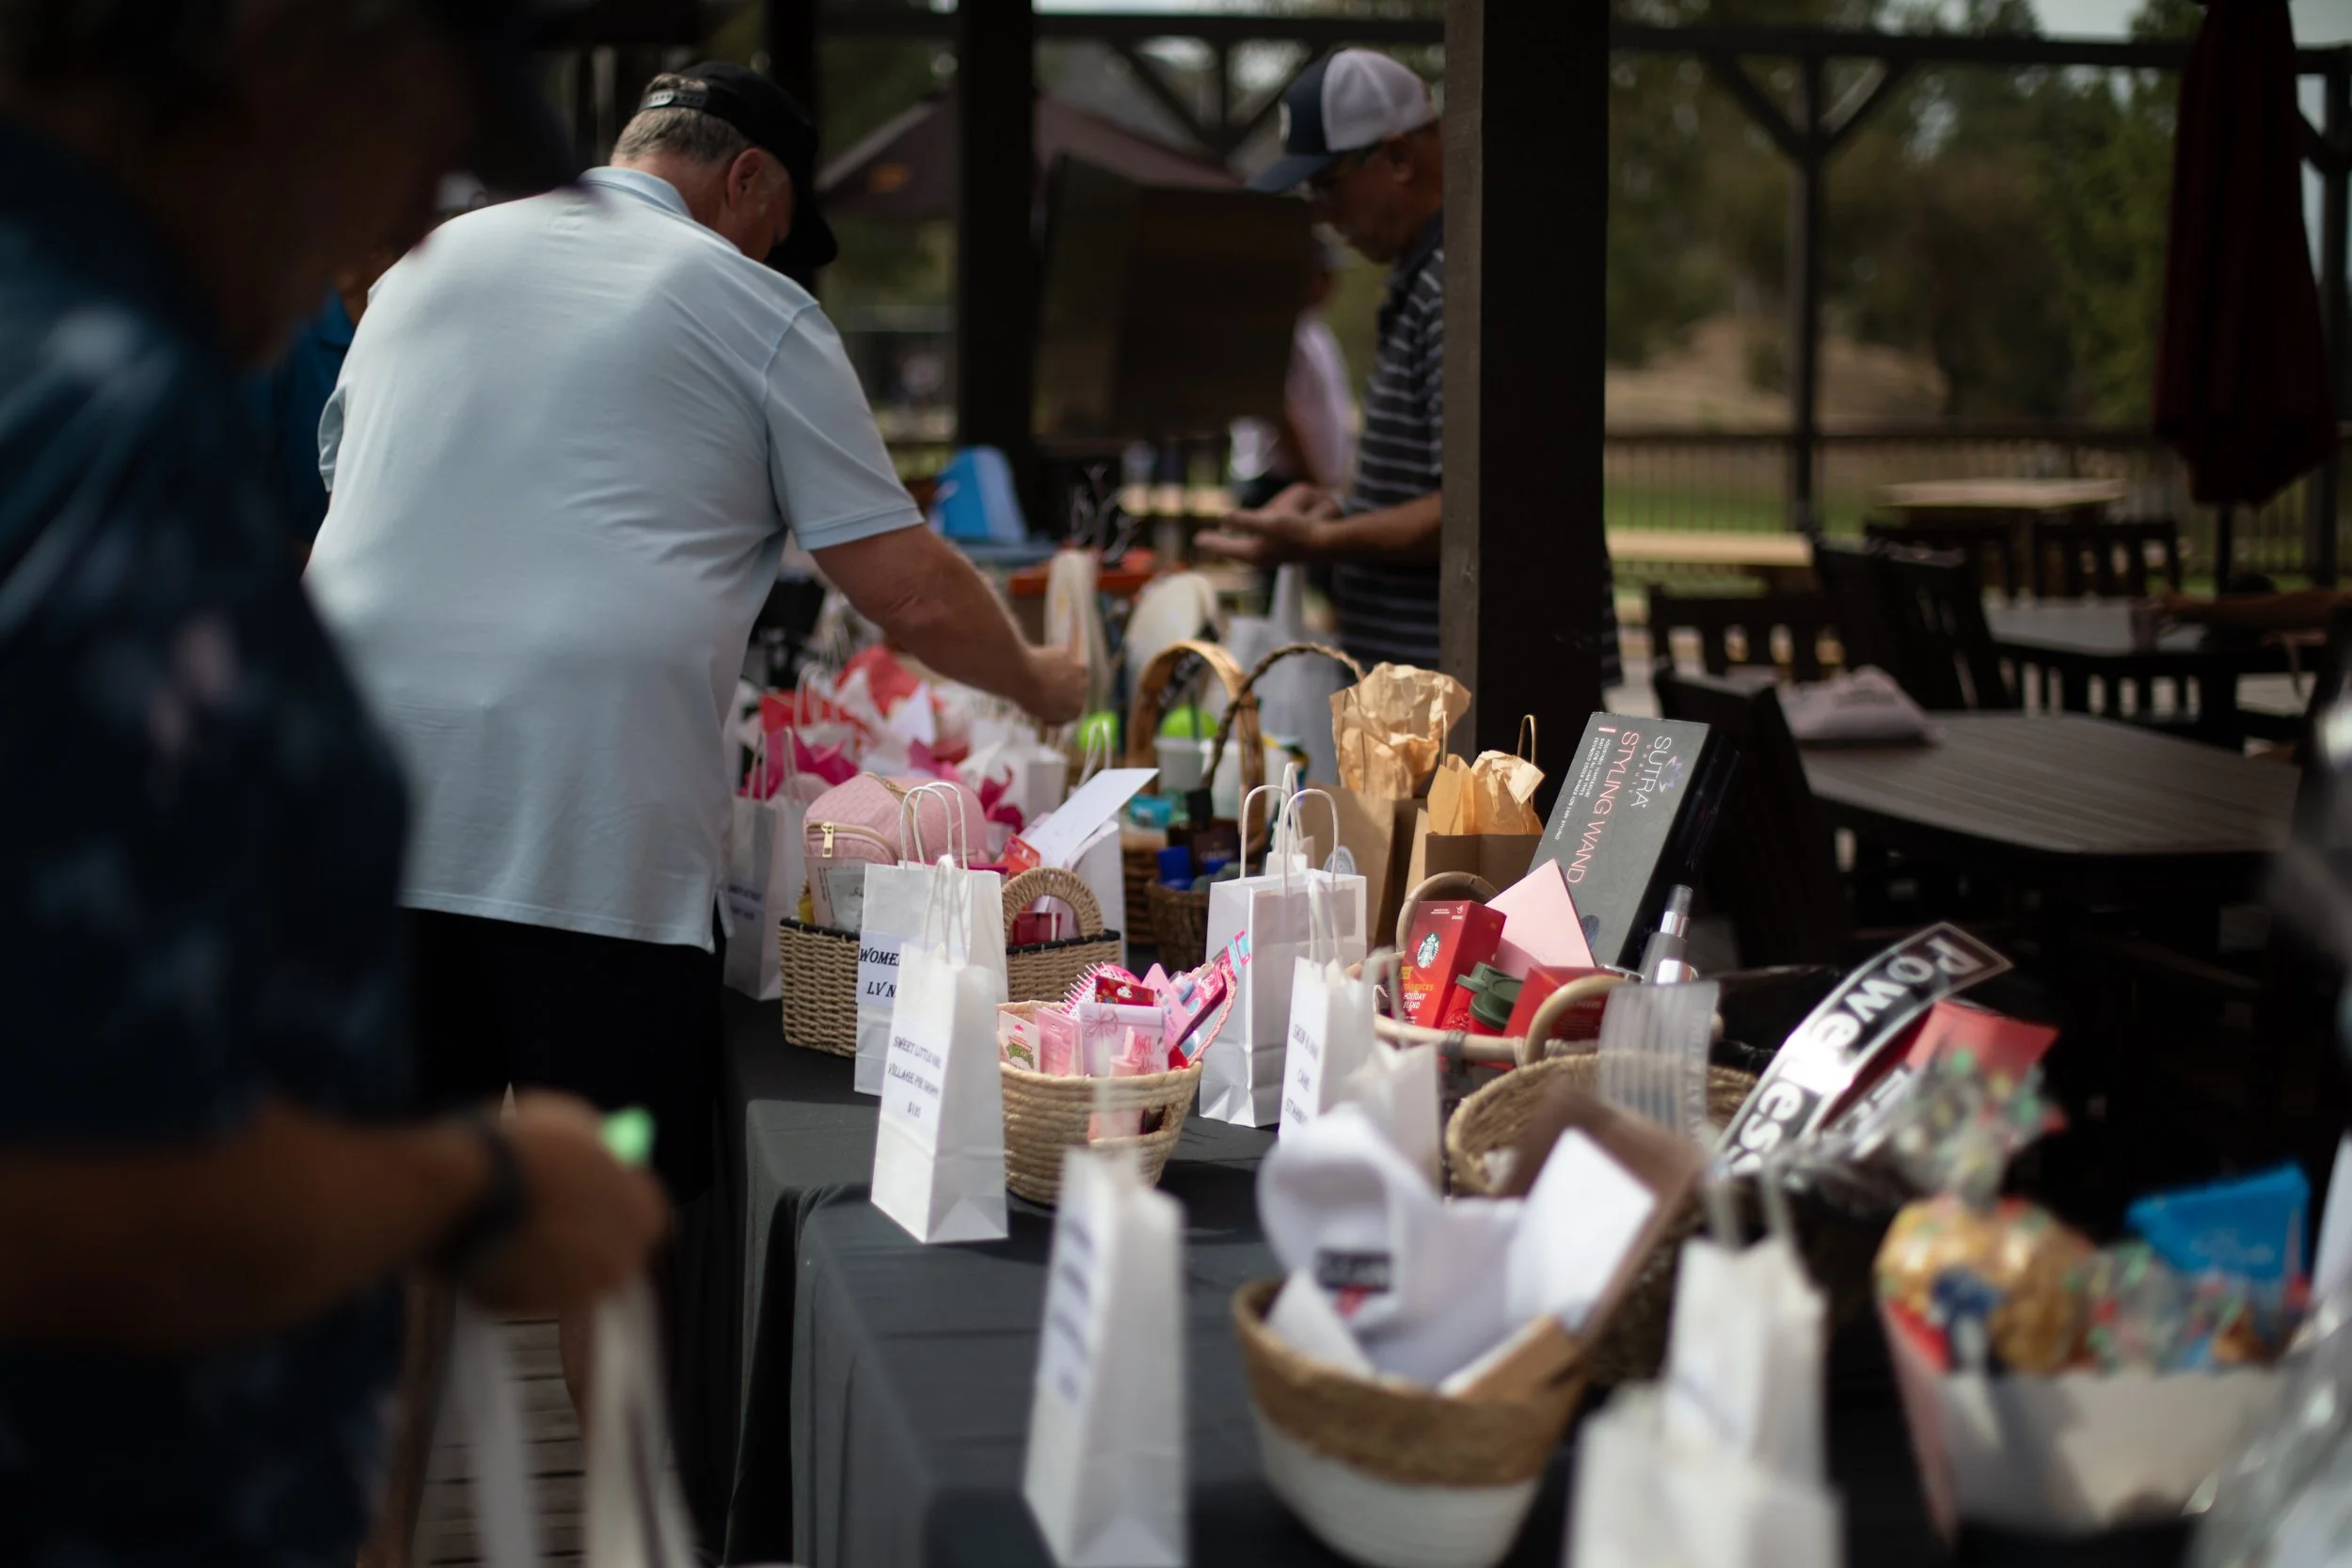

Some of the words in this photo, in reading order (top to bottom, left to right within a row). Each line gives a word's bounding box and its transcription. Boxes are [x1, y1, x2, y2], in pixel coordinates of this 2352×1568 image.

[1593, 731, 1640, 816] STYLING
[1629, 744, 1652, 794] beauty
[1630, 736, 1672, 808] SUTRA
[1566, 821, 1606, 883] WAND
[859, 947, 899, 967] WOME
[866, 981, 885, 995] LV
[1403, 983, 1434, 991] TARBUCKS
[893, 1036, 915, 1054] SWEET
[1727, 937, 1986, 1174] Poweess
[888, 1062, 915, 1085] VILLAGE
